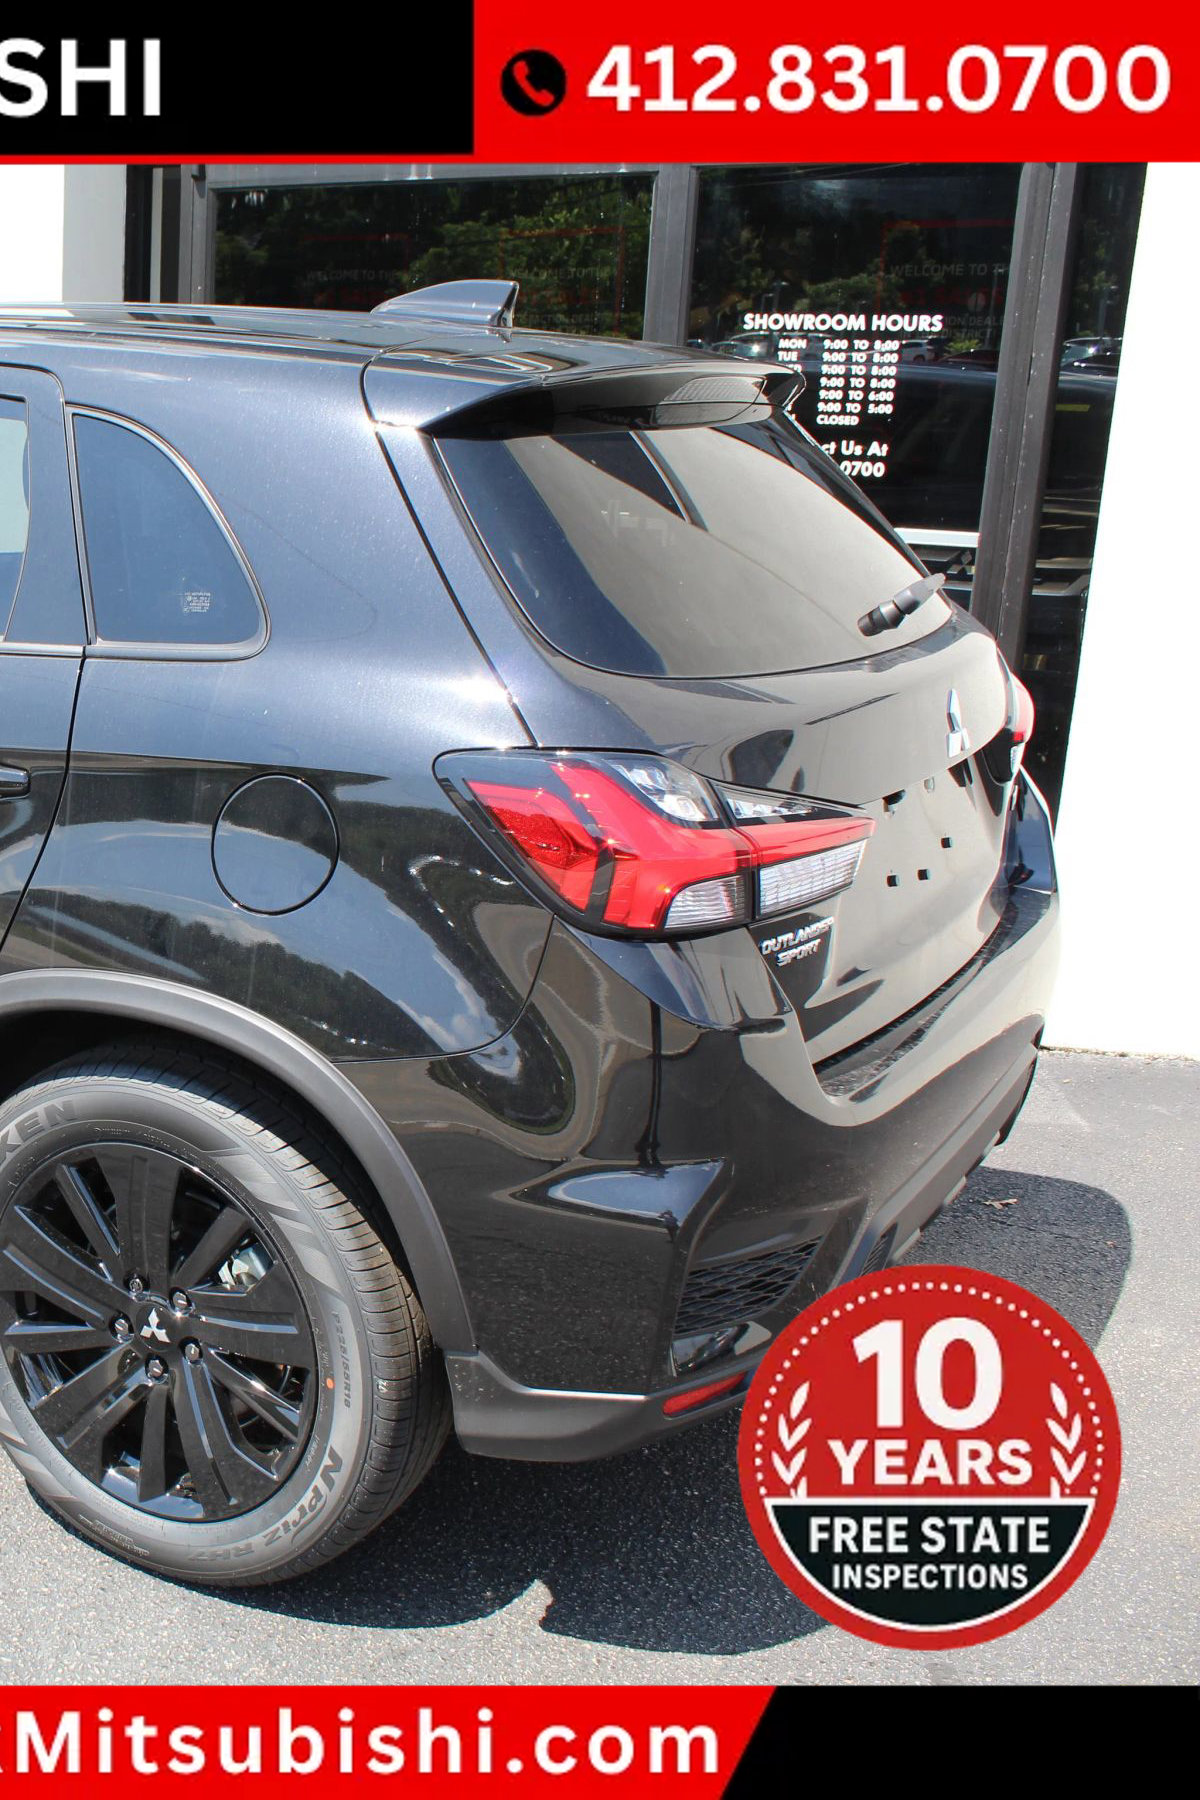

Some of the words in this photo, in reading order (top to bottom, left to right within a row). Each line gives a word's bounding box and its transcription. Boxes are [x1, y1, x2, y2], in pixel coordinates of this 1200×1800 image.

[743, 313, 866, 331] SHOWROOM
[871, 314, 944, 332] HOURS
[778, 338, 807, 349] MON
[823, 339, 849, 350] 9:00
[853, 340, 869, 350] TO
[874, 340, 900, 351] 8:00
[777, 351, 798, 361] TUE
[822, 352, 846, 363] 9:00
[852, 352, 867, 362] TO
[873, 353, 898, 364] 8:00
[821, 364, 846, 375] 9:00
[850, 365, 866, 375] TO
[871, 366, 897, 376] 8:00
[820, 377, 845, 387] 9:00
[849, 377, 865, 388] TO
[870, 378, 896, 389] 8:00
[818, 389, 843, 400] 9:00
[848, 390, 864, 400] TO
[817, 402, 841, 413] 9:00
[846, 402, 861, 413] TO
[816, 414, 859, 426] CLOSED
[841, 440, 862, 456] Us
[867, 441, 888, 457] At
[760, 916, 835, 955] OUTLANDER
[776, 939, 822, 966] SPORT
